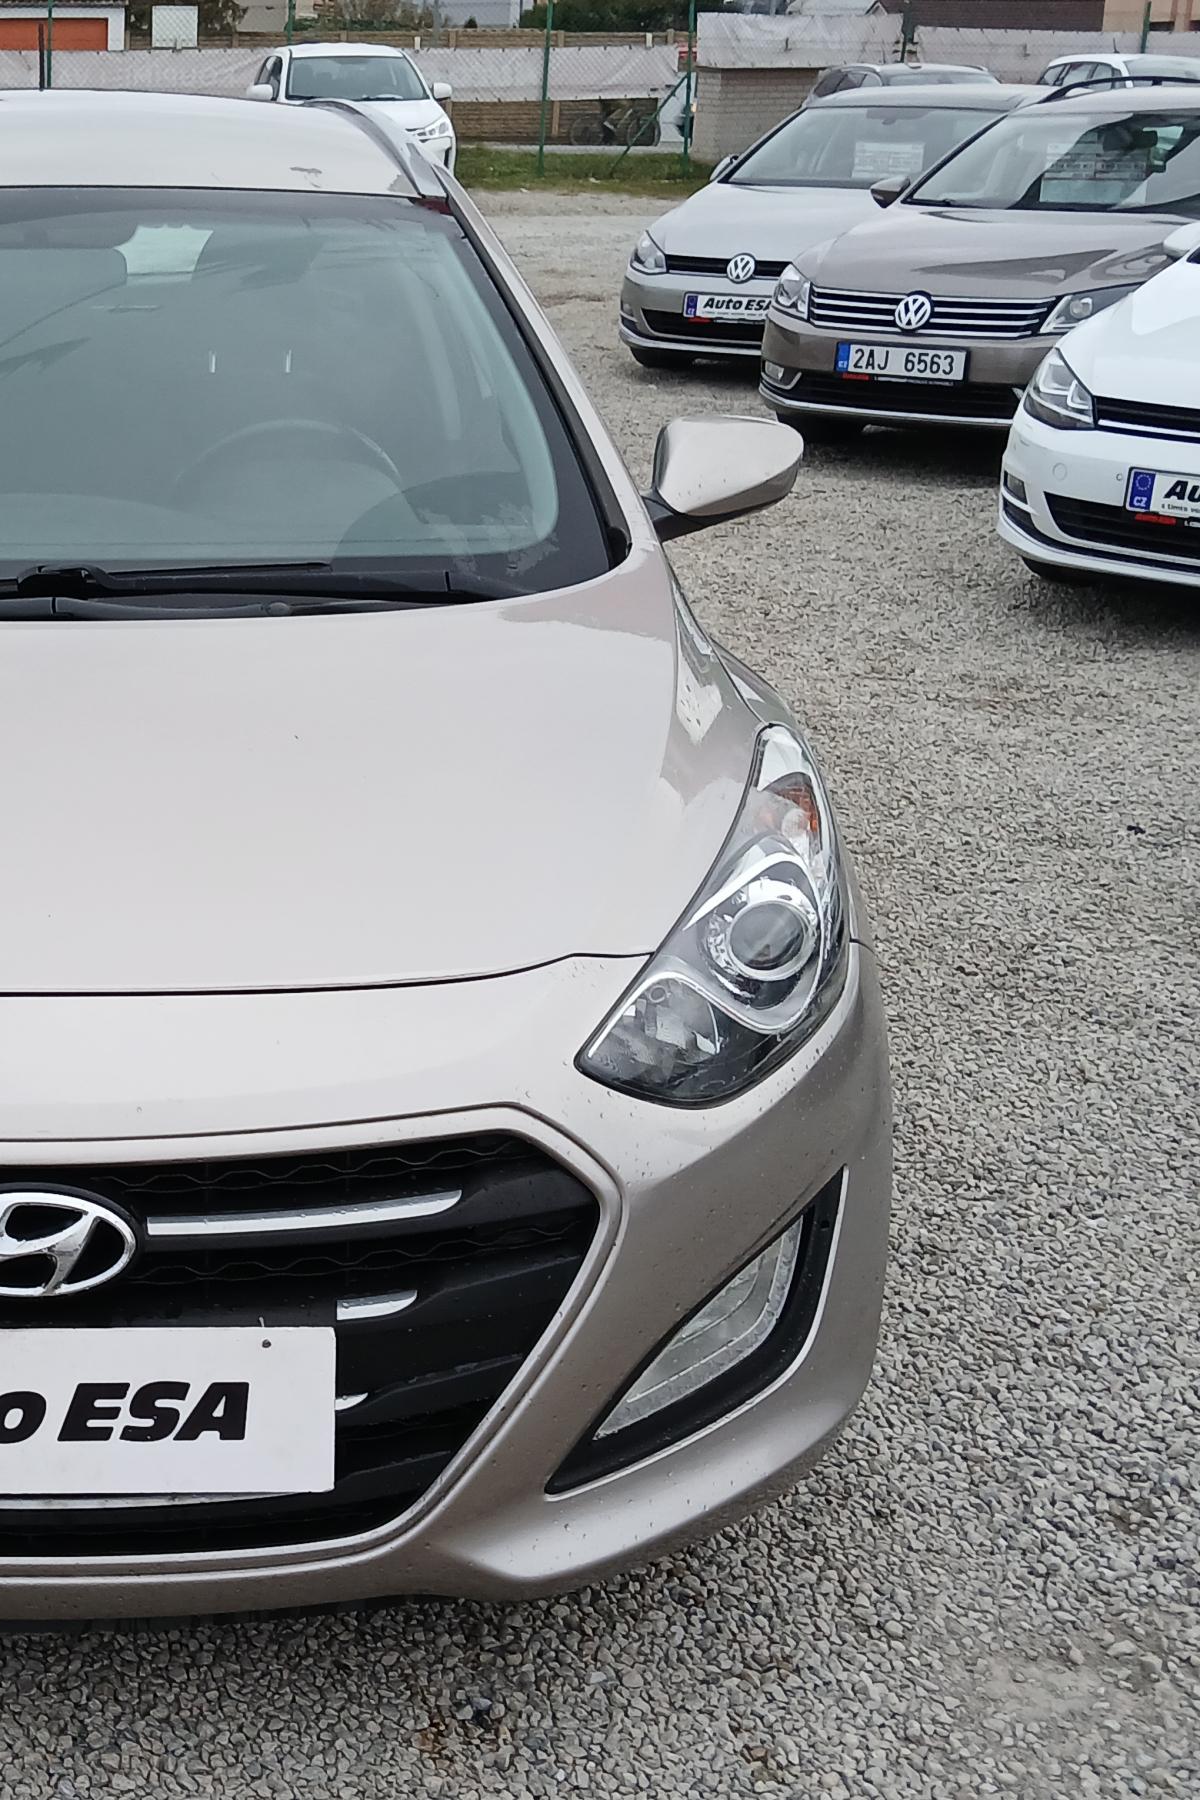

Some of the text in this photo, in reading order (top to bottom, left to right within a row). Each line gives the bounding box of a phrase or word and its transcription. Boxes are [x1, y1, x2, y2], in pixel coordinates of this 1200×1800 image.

[703, 297, 743, 310] Auto
[853, 348, 955, 376] 2AJ 6563
[1133, 496, 1148, 507] CZ
[56, 1381, 250, 1442] ESA
